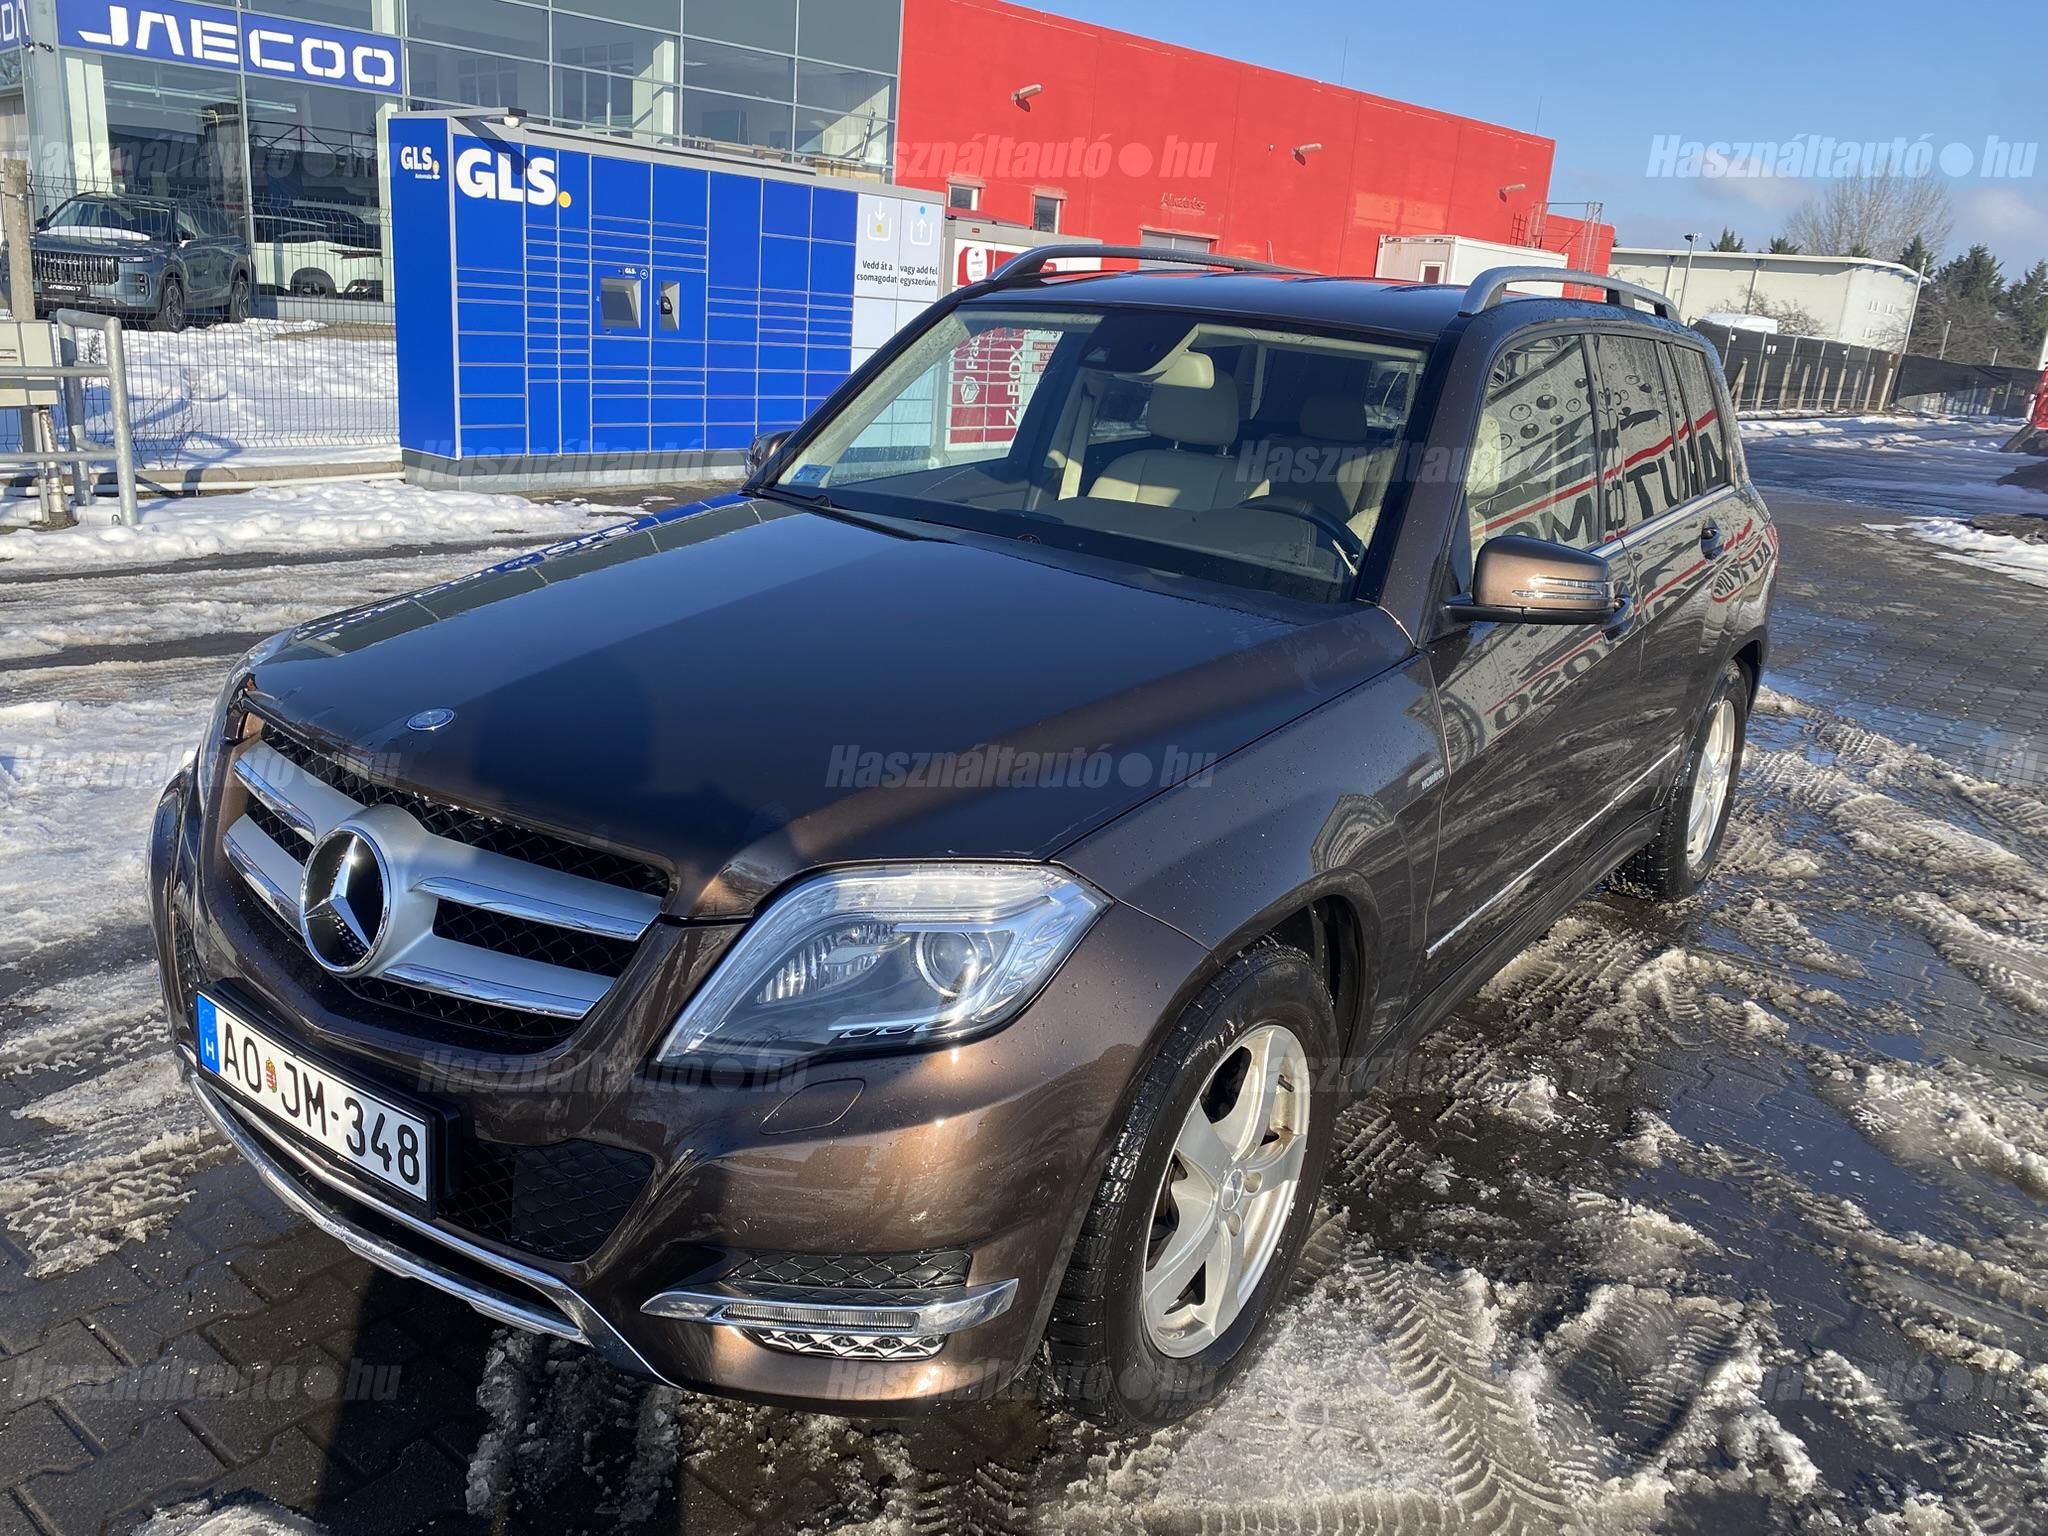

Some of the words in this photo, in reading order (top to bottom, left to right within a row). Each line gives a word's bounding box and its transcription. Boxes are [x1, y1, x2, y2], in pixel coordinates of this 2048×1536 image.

[77, 5, 395, 87] JAECOO
[862, 259, 880, 270] Vedd
[880, 261, 888, 271] át
[888, 263, 893, 271] a
[900, 265, 916, 276] vagy
[916, 265, 929, 275] add
[929, 266, 938, 276] fel
[856, 273, 898, 285] csomagodat
[1005, 344, 1024, 426] Z-BOX
[206, 1040, 216, 1061] H
[224, 1023, 263, 1094] AO
[281, 1060, 420, 1186] JM-348
